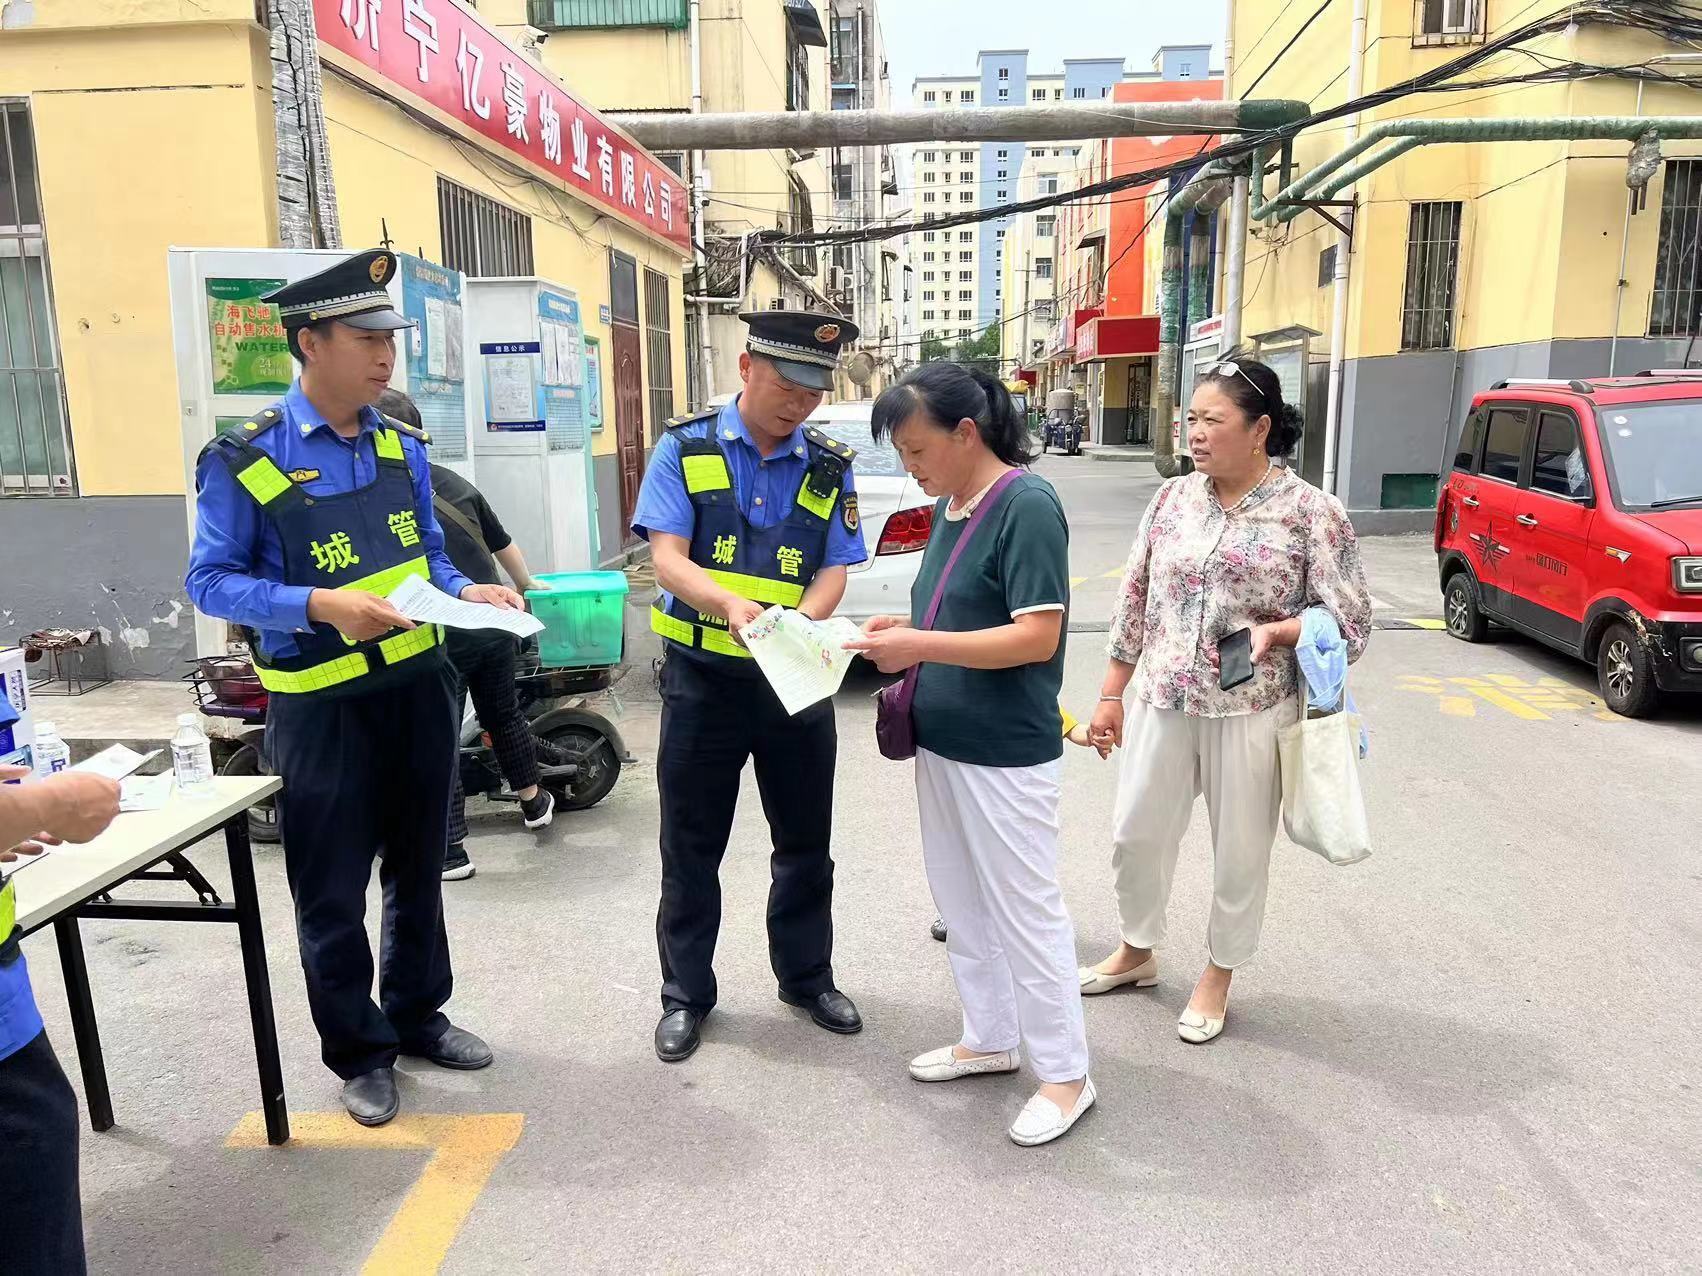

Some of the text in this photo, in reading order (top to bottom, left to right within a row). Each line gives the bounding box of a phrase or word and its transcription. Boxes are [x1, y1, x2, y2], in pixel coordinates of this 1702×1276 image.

[214, 322, 287, 337] 自动售水机
[235, 342, 290, 352] WATER
[495, 344, 526, 354] 信息公示
[310, 510, 420, 574] 城管
[711, 534, 804, 577] 城管
